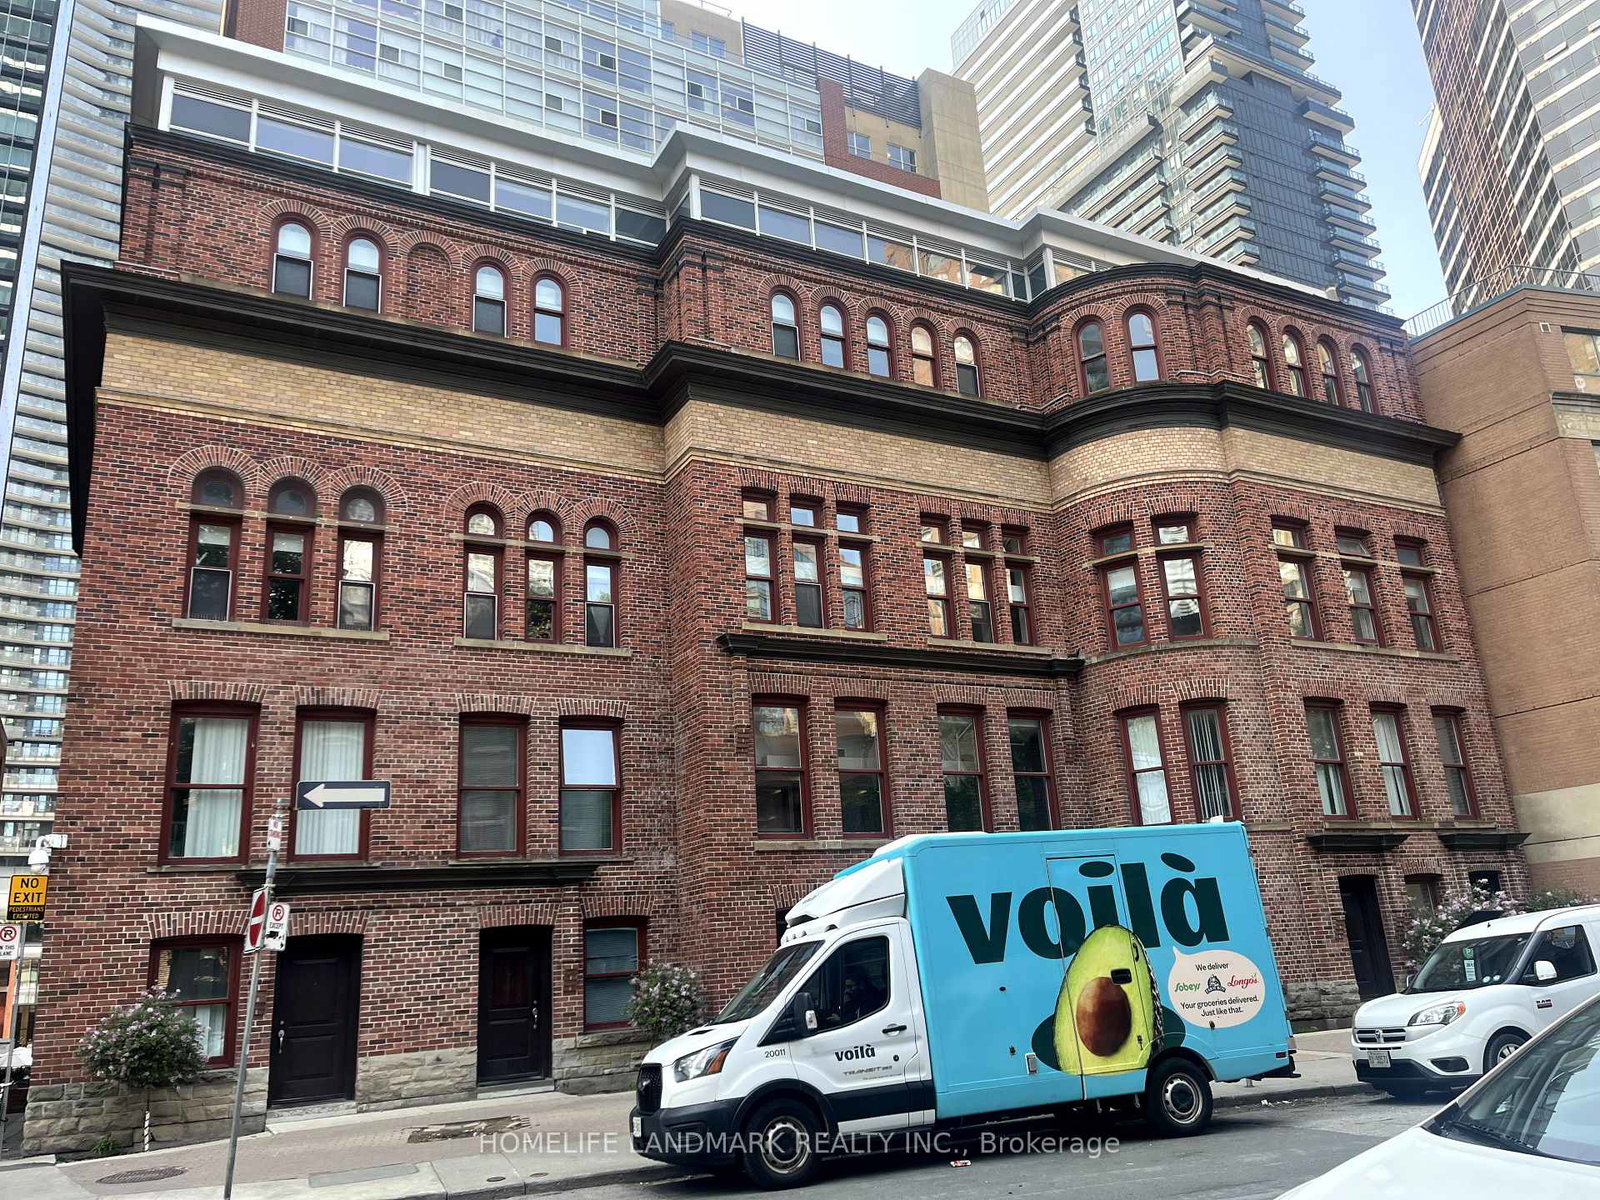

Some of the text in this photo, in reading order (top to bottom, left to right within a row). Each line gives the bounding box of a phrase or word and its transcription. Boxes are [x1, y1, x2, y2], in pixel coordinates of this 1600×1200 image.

[20, 877, 39, 889] NO
[13, 892, 43, 903] EXIT
[1195, 962, 1229, 971] We deliver
[1174, 983, 1201, 992] Sobeys
[1196, 998, 1227, 1009] groceries
[1227, 995, 1259, 1003] delivered.
[1201, 1009, 1216, 1017] Just
[1228, 1006, 1244, 1014] that.
[764, 1049, 786, 1058] 20011
